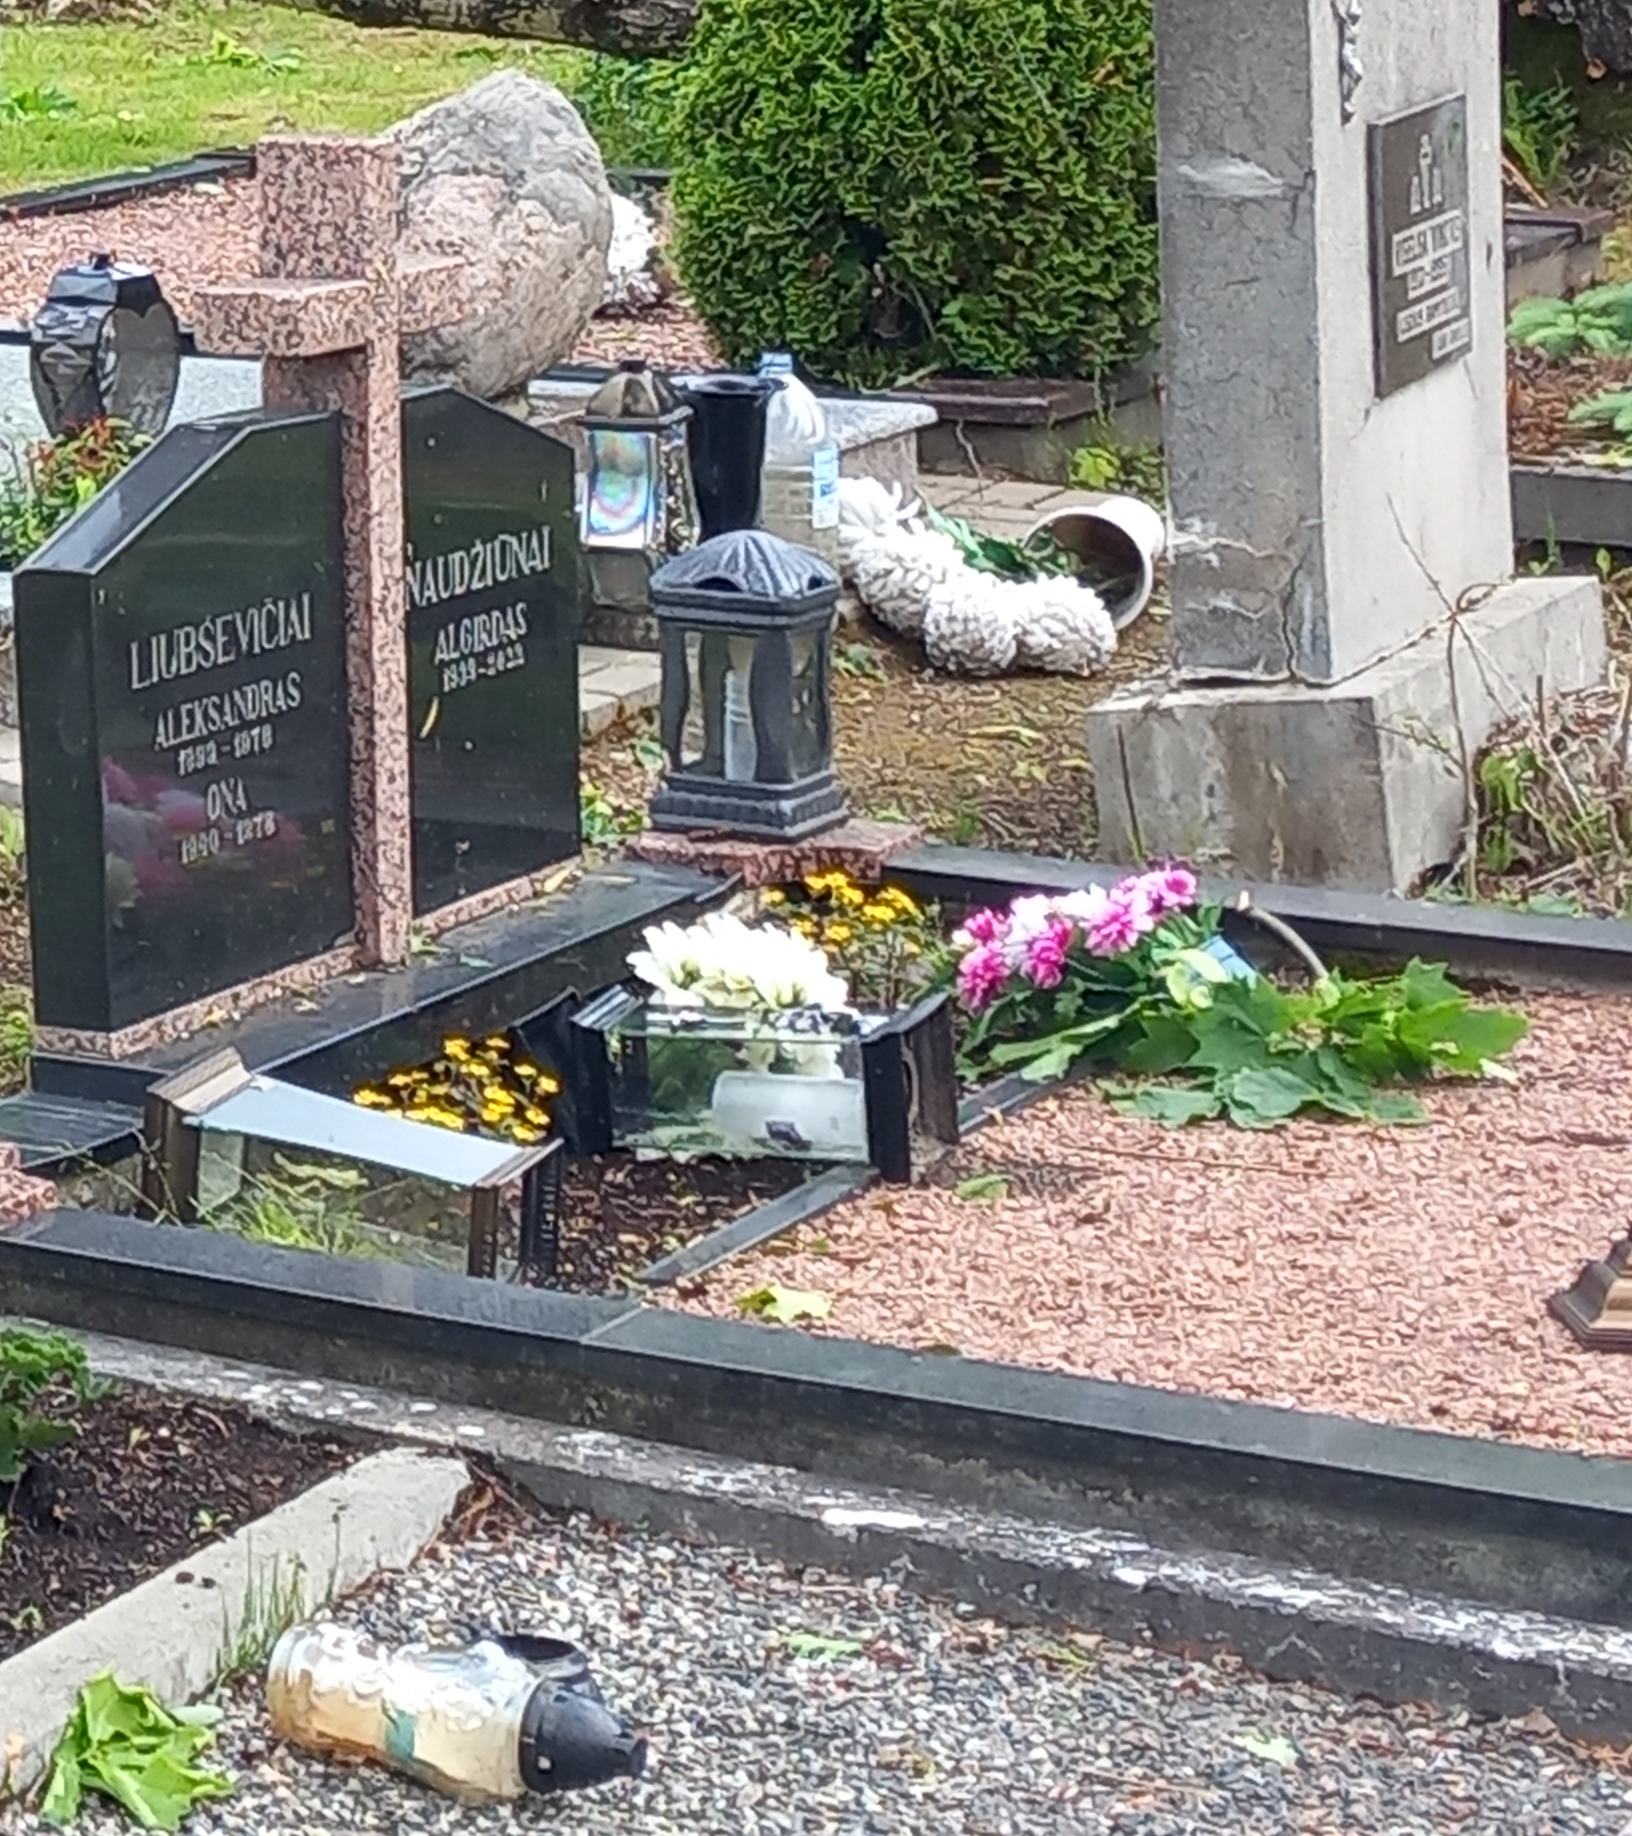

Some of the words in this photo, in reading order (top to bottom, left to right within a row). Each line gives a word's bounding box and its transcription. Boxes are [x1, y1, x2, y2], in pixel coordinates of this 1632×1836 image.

[434, 602, 527, 665] ALGIRDAS
[154, 671, 301, 751] ALEKSANDRAS
[207, 777, 247, 821] ONA
